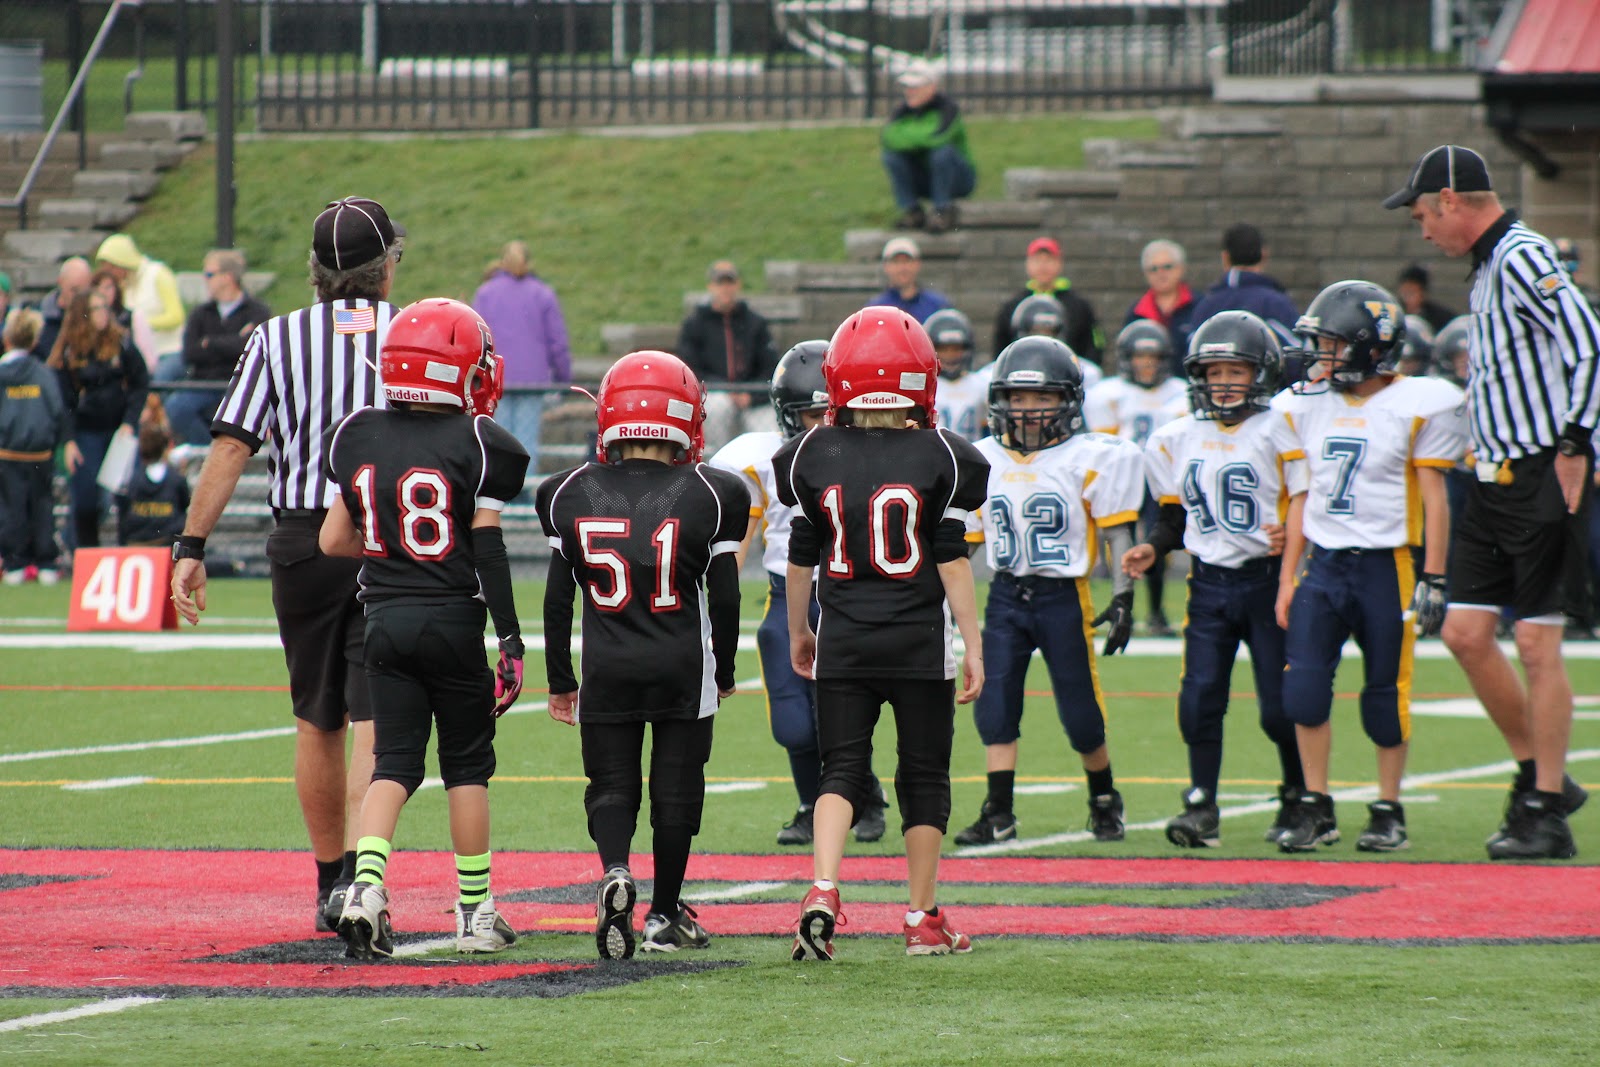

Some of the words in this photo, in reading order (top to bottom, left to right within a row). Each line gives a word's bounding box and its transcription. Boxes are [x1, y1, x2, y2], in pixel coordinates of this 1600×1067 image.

[385, 388, 430, 401] Riddell
[619, 425, 669, 438] Riddell
[861, 396, 898, 405] Riddell
[352, 463, 455, 561] 18
[1180, 458, 1261, 535] 46
[1322, 436, 1368, 514] 7
[574, 517, 683, 614] 51
[820, 483, 923, 579] 10
[989, 492, 1071, 571] 32
[80, 554, 155, 624] 40
